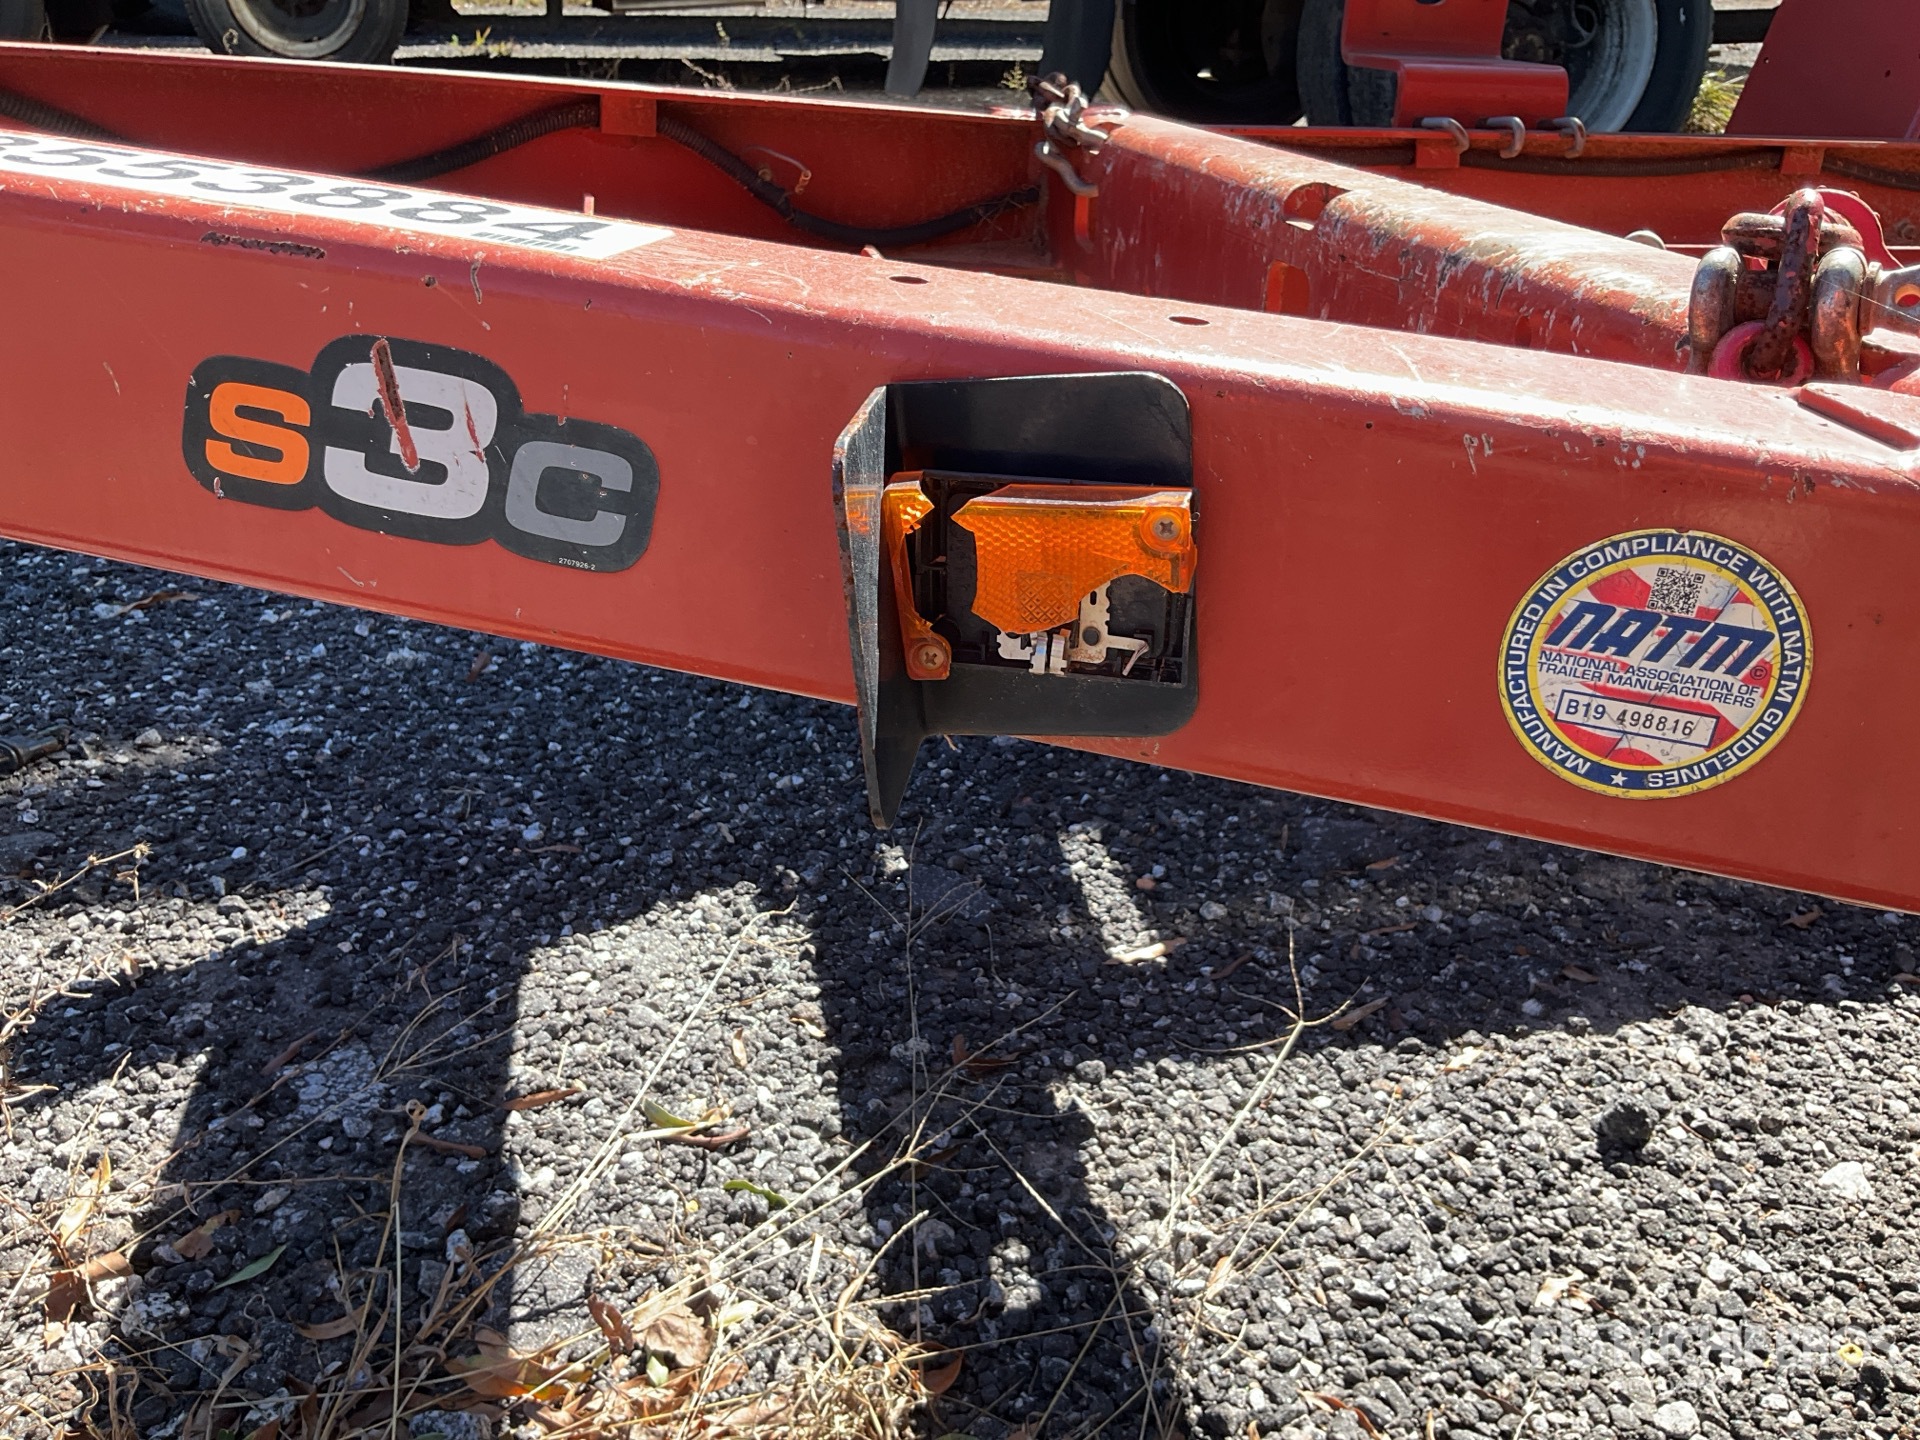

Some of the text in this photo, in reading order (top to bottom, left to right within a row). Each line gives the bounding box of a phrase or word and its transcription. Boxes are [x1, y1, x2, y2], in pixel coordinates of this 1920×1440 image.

[1507, 536, 1802, 788] MANUFACTURED IN COMPLIANCE WITH NATM GUIDELINES
[1538, 661, 1756, 708] TRAILER MANUFACTURERS
[1540, 652, 1760, 696] NATIONAL ASSOCIATION OF
[1565, 698, 1695, 736] B19 498816
